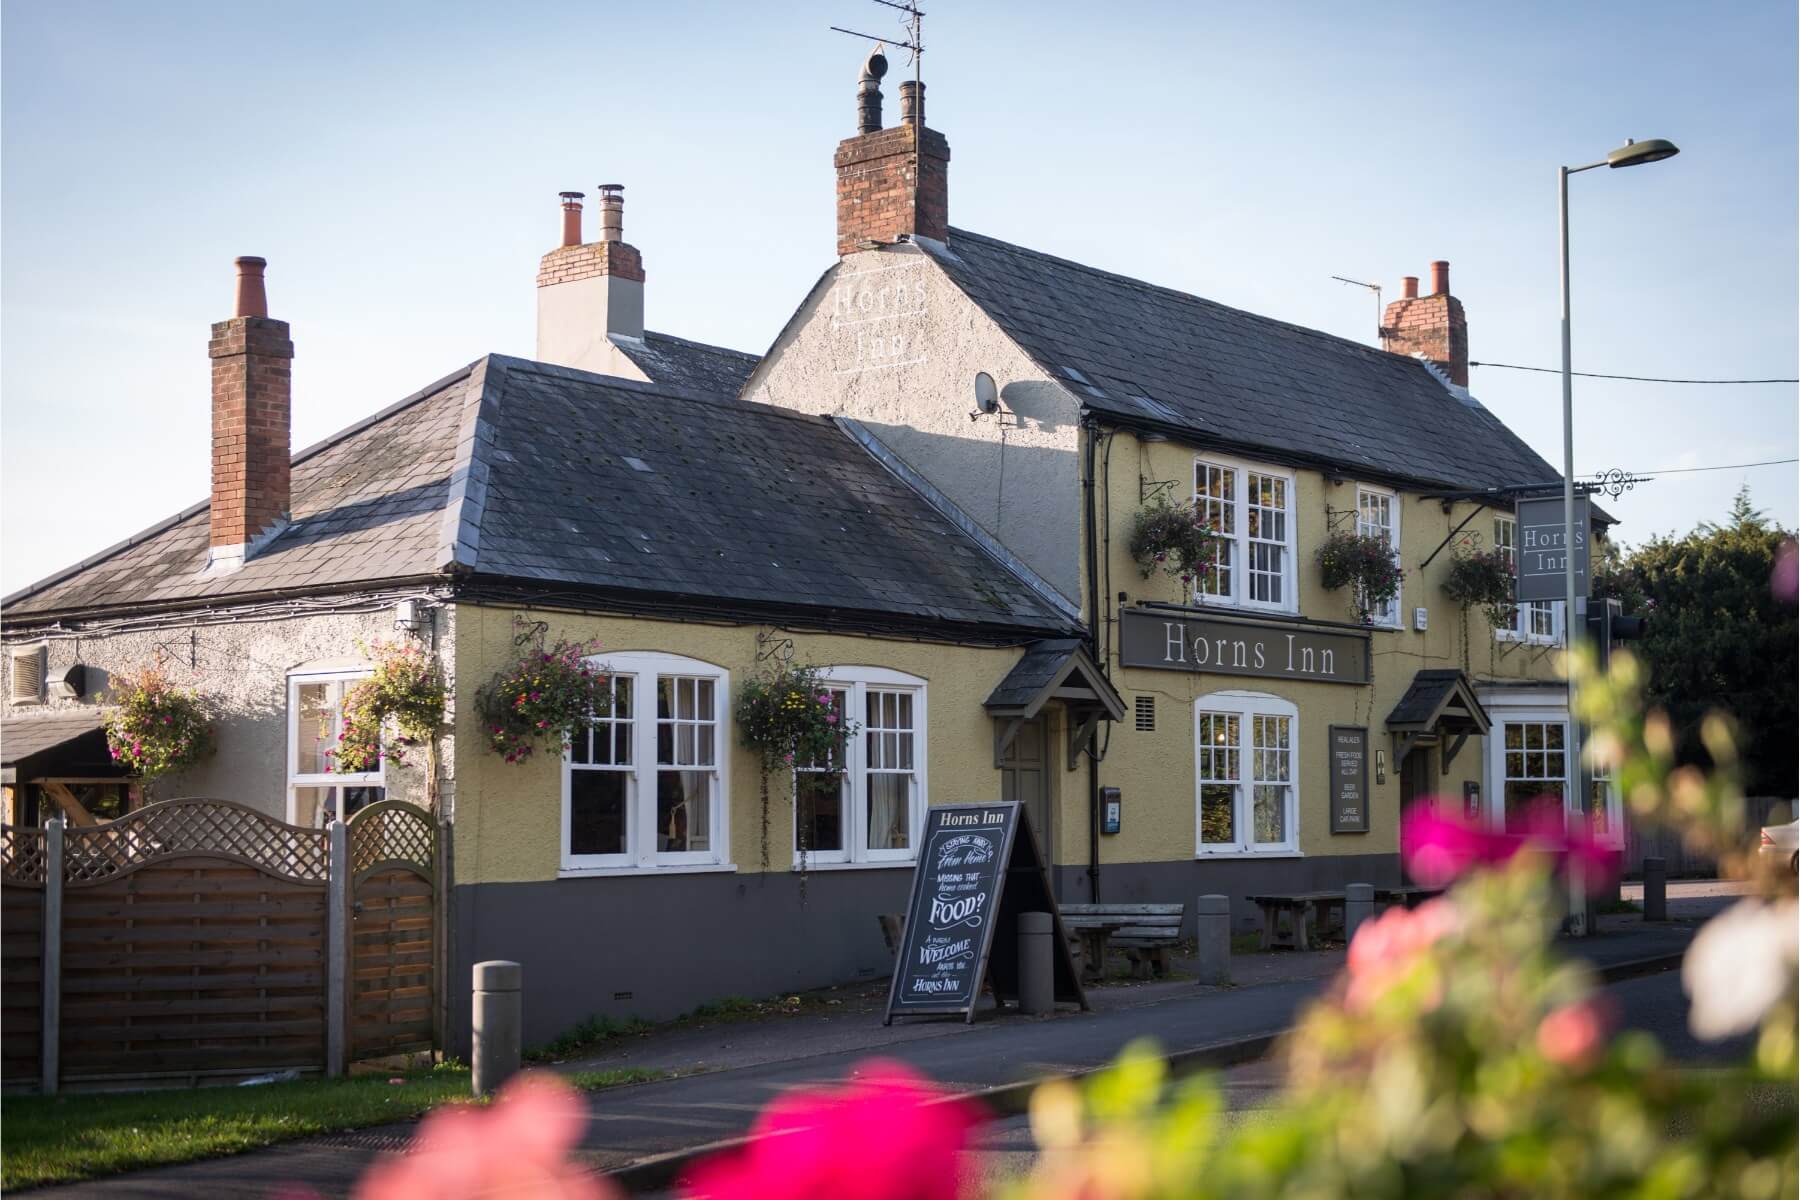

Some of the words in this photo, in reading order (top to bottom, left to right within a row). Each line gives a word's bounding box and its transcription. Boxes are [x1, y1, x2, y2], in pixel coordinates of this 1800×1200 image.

[833, 281, 927, 315] Horns
[1163, 622, 1265, 669] Horns
[1285, 634, 1335, 674] Inn
[940, 812, 979, 826] Horns
[983, 811, 1004, 825] Inn
[965, 872, 981, 881] THAT
[928, 892, 985, 924] FOOD?
[920, 938, 971, 965] WELCOME
[913, 978, 943, 993] HORNS
[943, 977, 961, 992] INN
